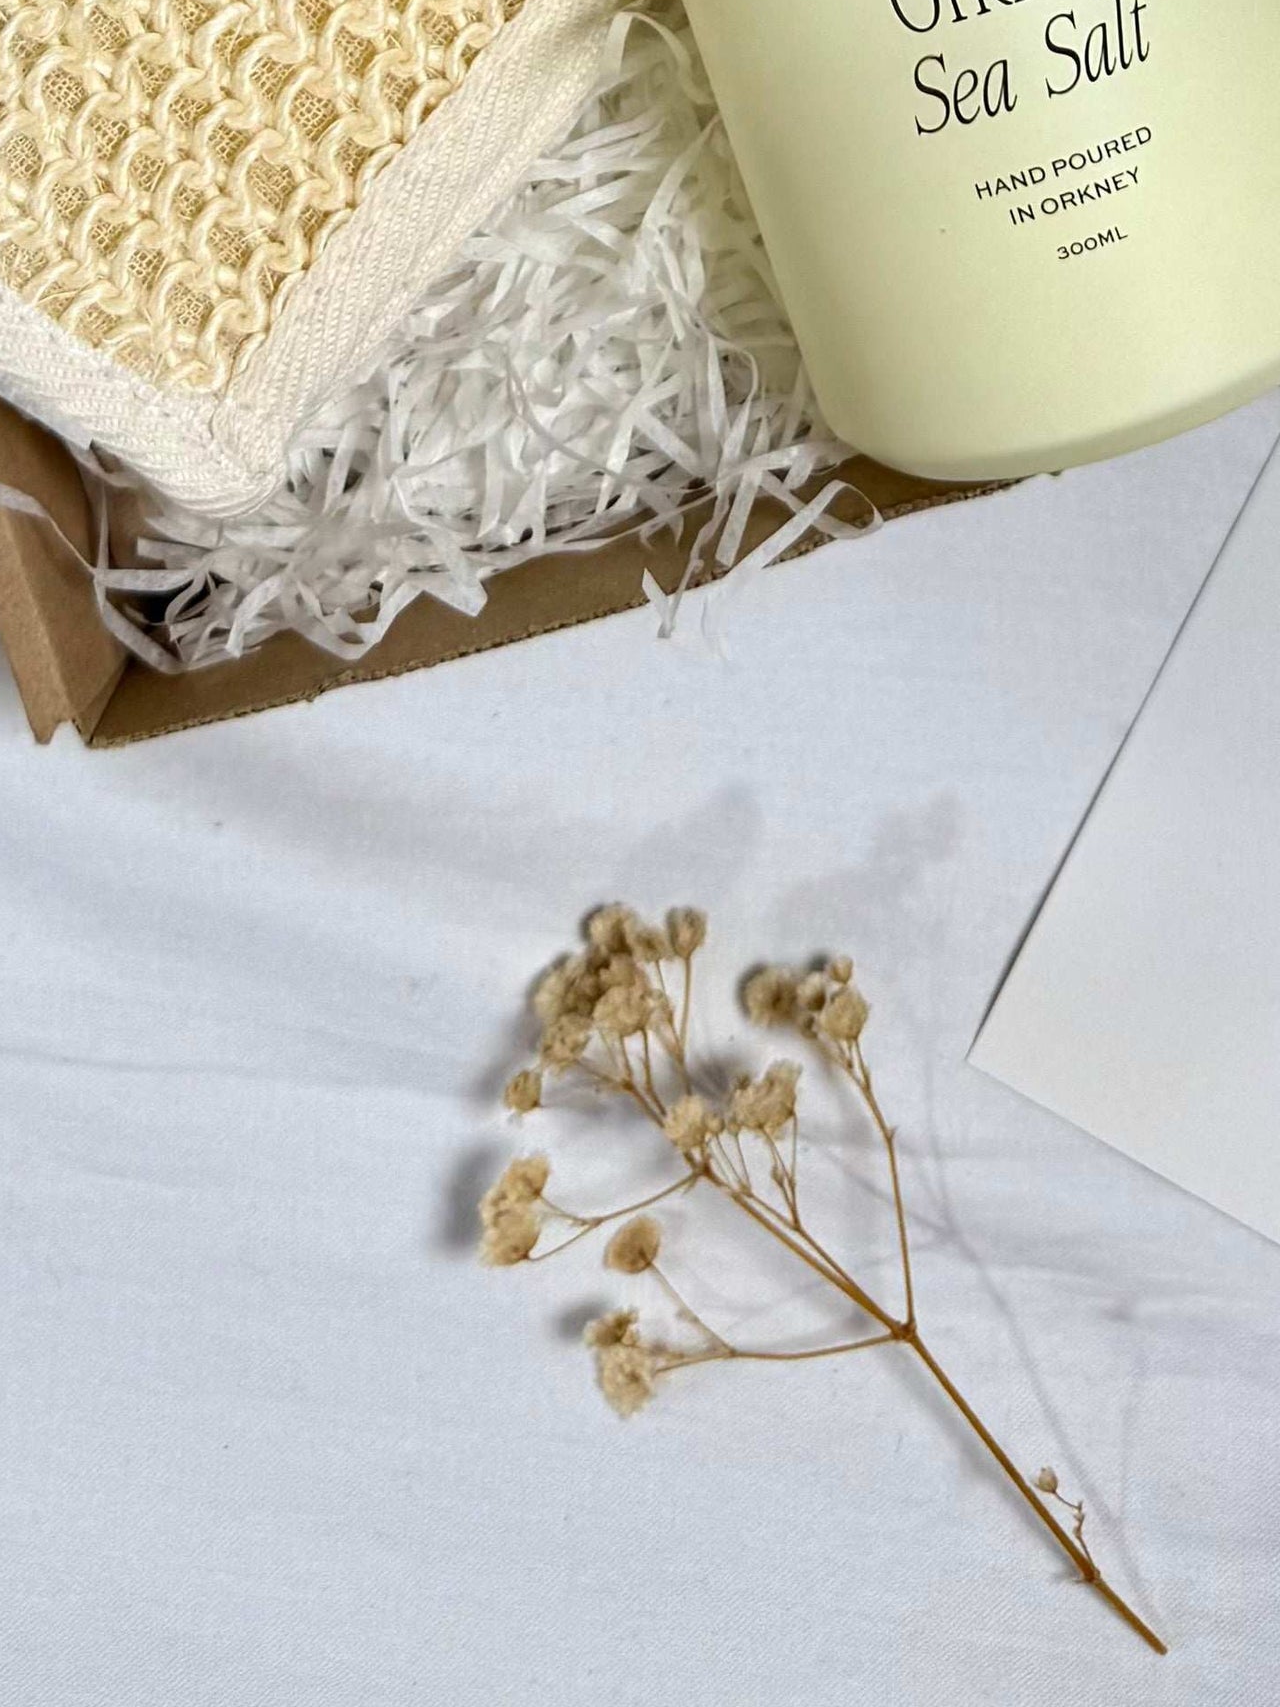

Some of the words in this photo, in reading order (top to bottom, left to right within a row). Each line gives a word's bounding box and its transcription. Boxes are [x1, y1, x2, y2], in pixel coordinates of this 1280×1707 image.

[914, 53, 1018, 136] Sea
[975, 166, 1047, 200] HAND
[1051, 126, 1152, 177] POURED
[1009, 204, 1036, 226] IN
[1040, 166, 1141, 215] ORKNEY
[1056, 226, 1129, 261] 300ML
